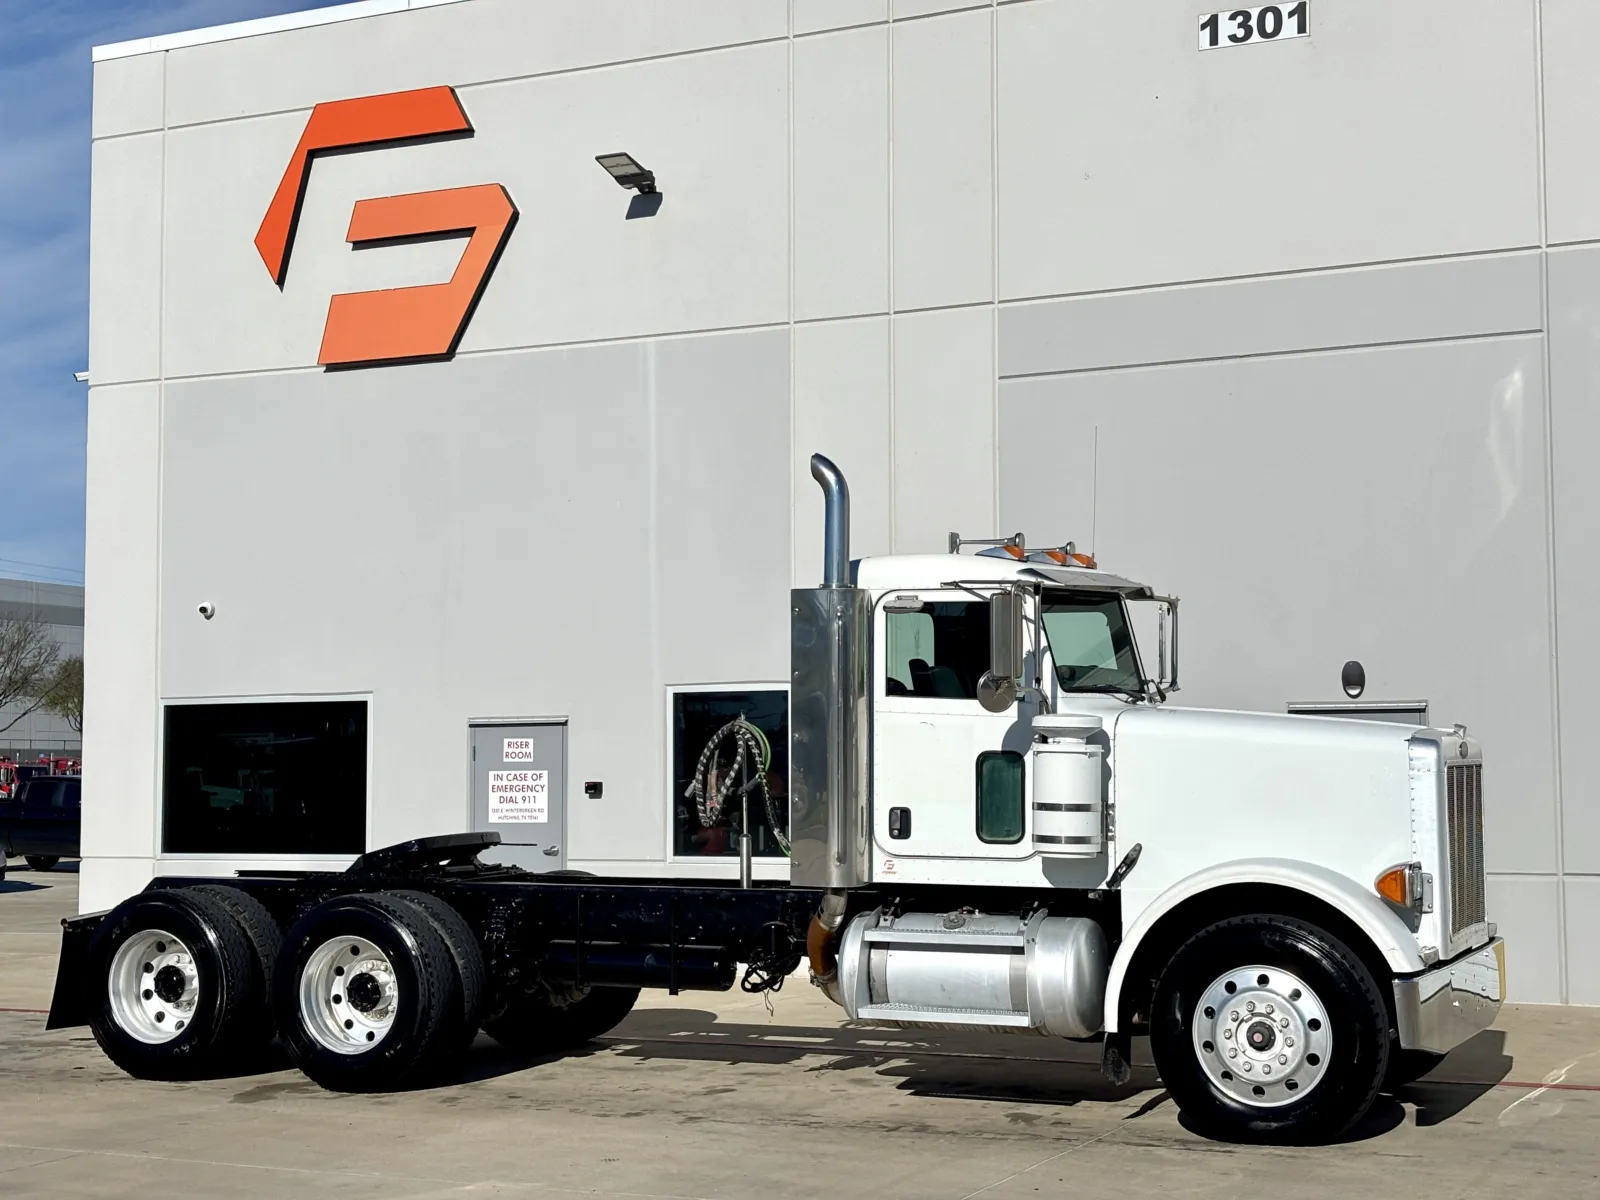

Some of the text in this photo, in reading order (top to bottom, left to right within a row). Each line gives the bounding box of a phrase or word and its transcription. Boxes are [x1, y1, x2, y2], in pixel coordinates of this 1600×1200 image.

[1200, 1, 1307, 47] 1301
[507, 741, 530, 749] RISER
[505, 751, 532, 759] ROOM
[493, 773, 543, 782] IN CASE OF
[491, 784, 545, 793] EMERGENCY
[499, 795, 536, 804] DIAL 911
